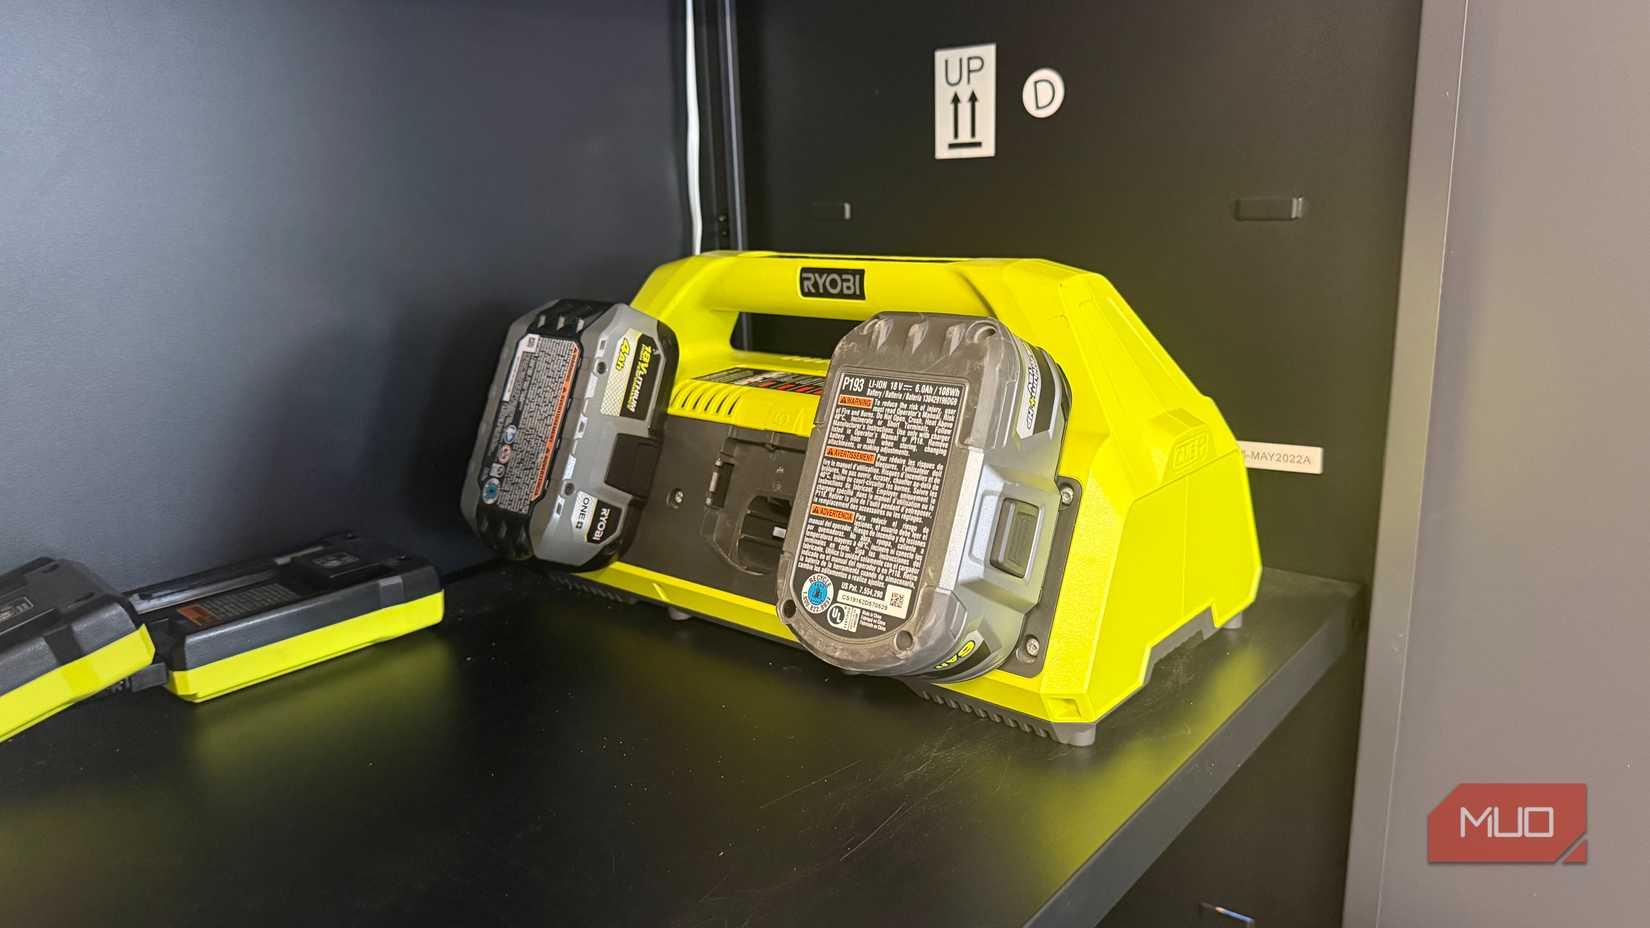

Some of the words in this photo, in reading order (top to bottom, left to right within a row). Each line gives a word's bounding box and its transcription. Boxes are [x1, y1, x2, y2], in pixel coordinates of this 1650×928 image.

[945, 56, 984, 87] UP
[1034, 79, 1055, 110] D
[801, 273, 860, 295] RYOBI
[616, 337, 630, 371] 4Ah
[842, 377, 865, 392] P193
[868, 380, 888, 389] LI-ION
[846, 397, 872, 407] WARNING
[834, 449, 873, 462] AVERTISSEMENT
[820, 508, 854, 521] ADVERTENCIA
[592, 508, 610, 541] RYOBI
